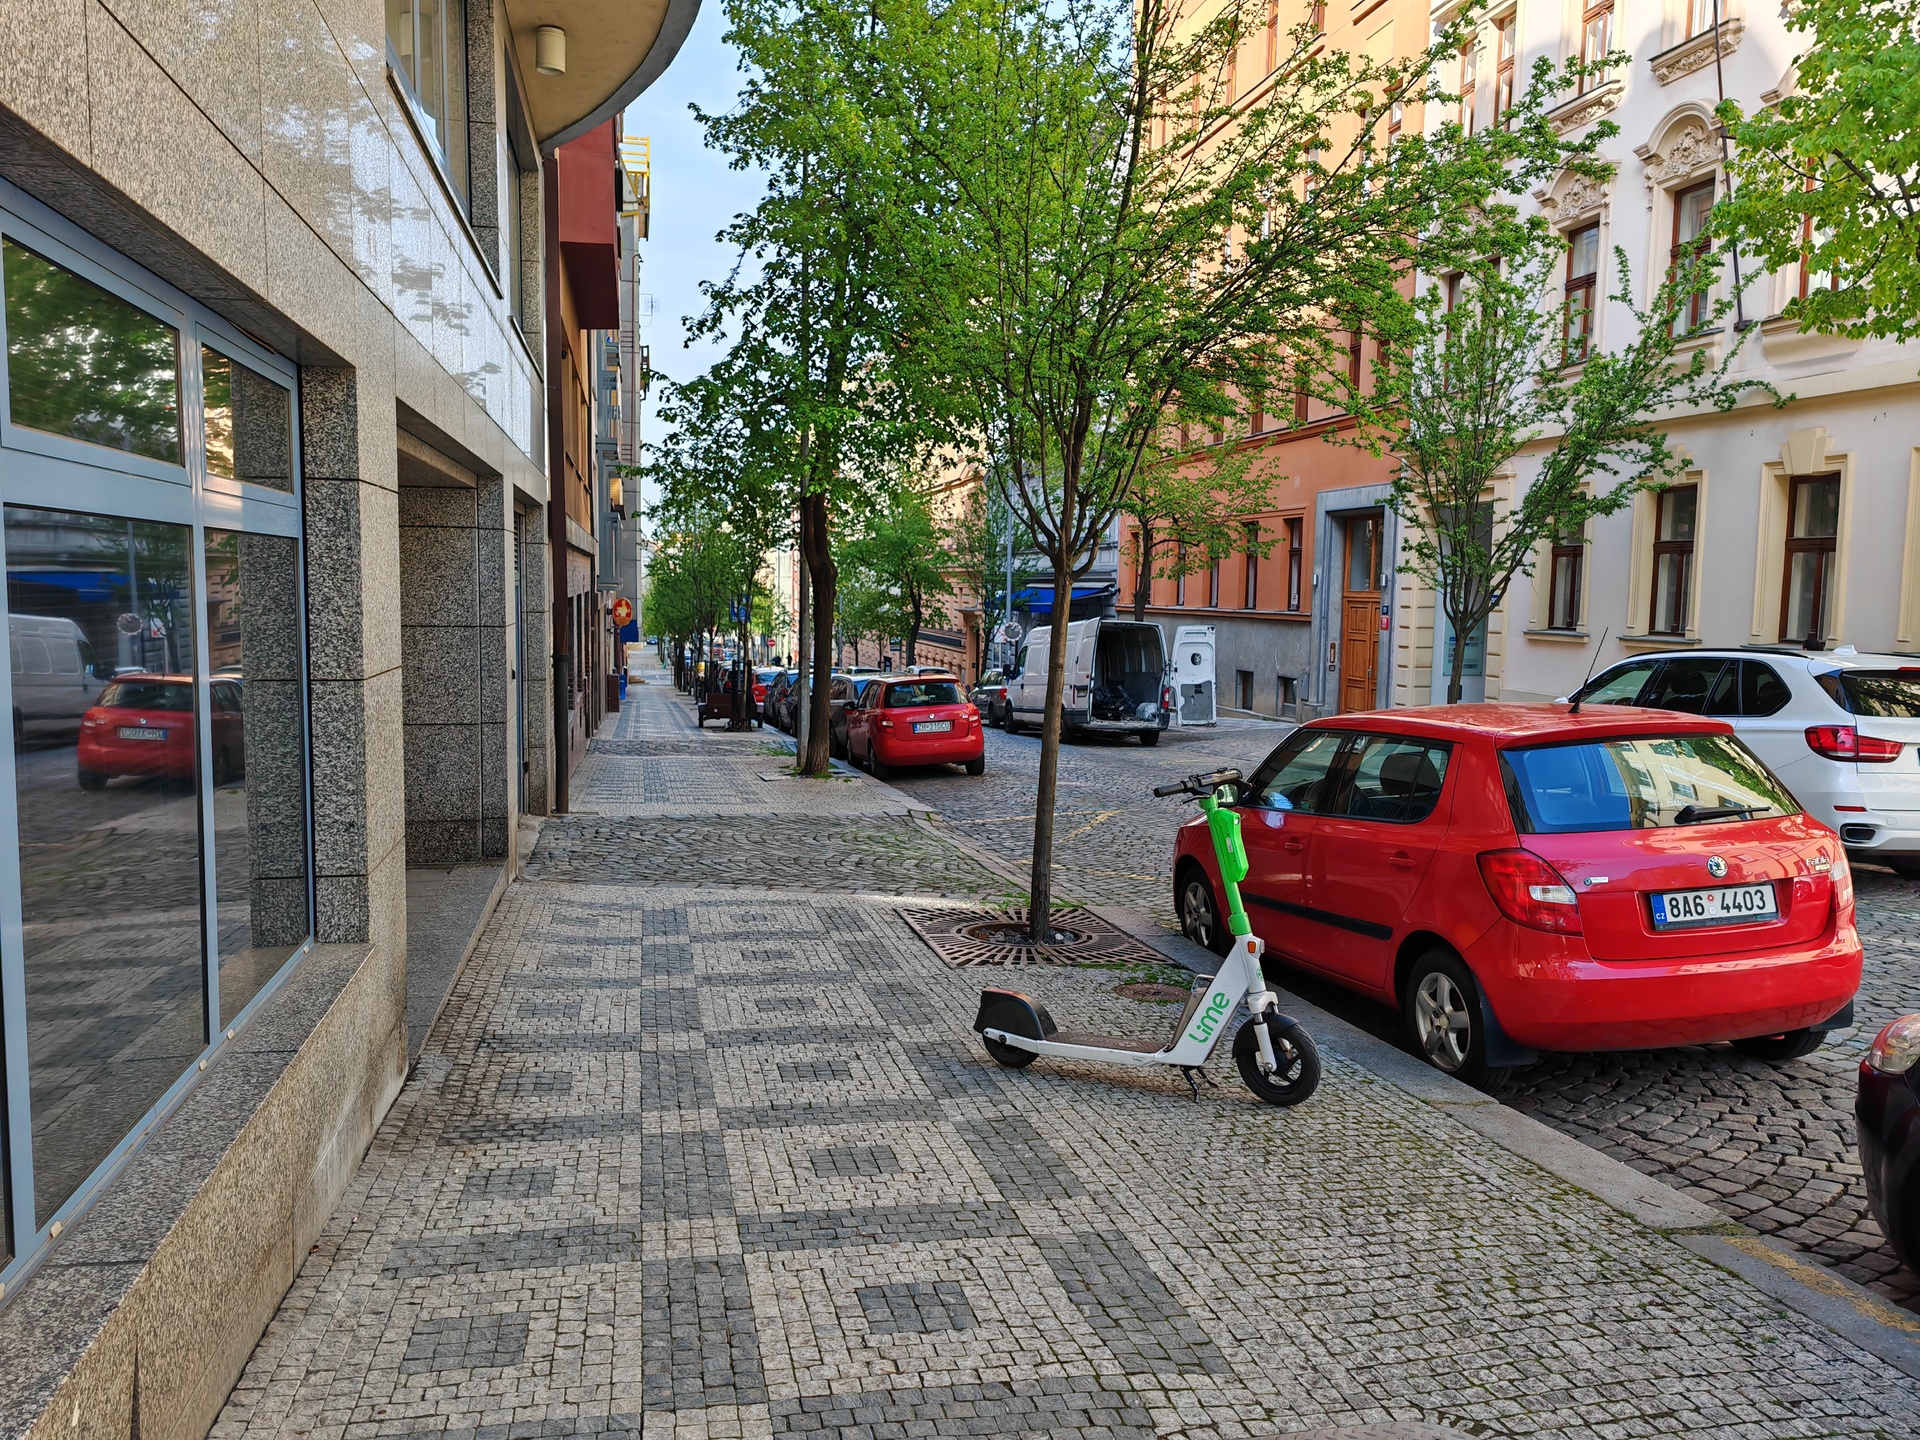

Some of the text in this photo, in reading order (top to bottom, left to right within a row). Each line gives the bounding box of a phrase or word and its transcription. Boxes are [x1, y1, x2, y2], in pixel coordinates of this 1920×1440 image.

[1806, 855, 1829, 866] Fabia
[1669, 889, 1766, 919] 8A6 4403
[1656, 912, 1666, 920] CZ
[1188, 992, 1230, 1044] Lime
